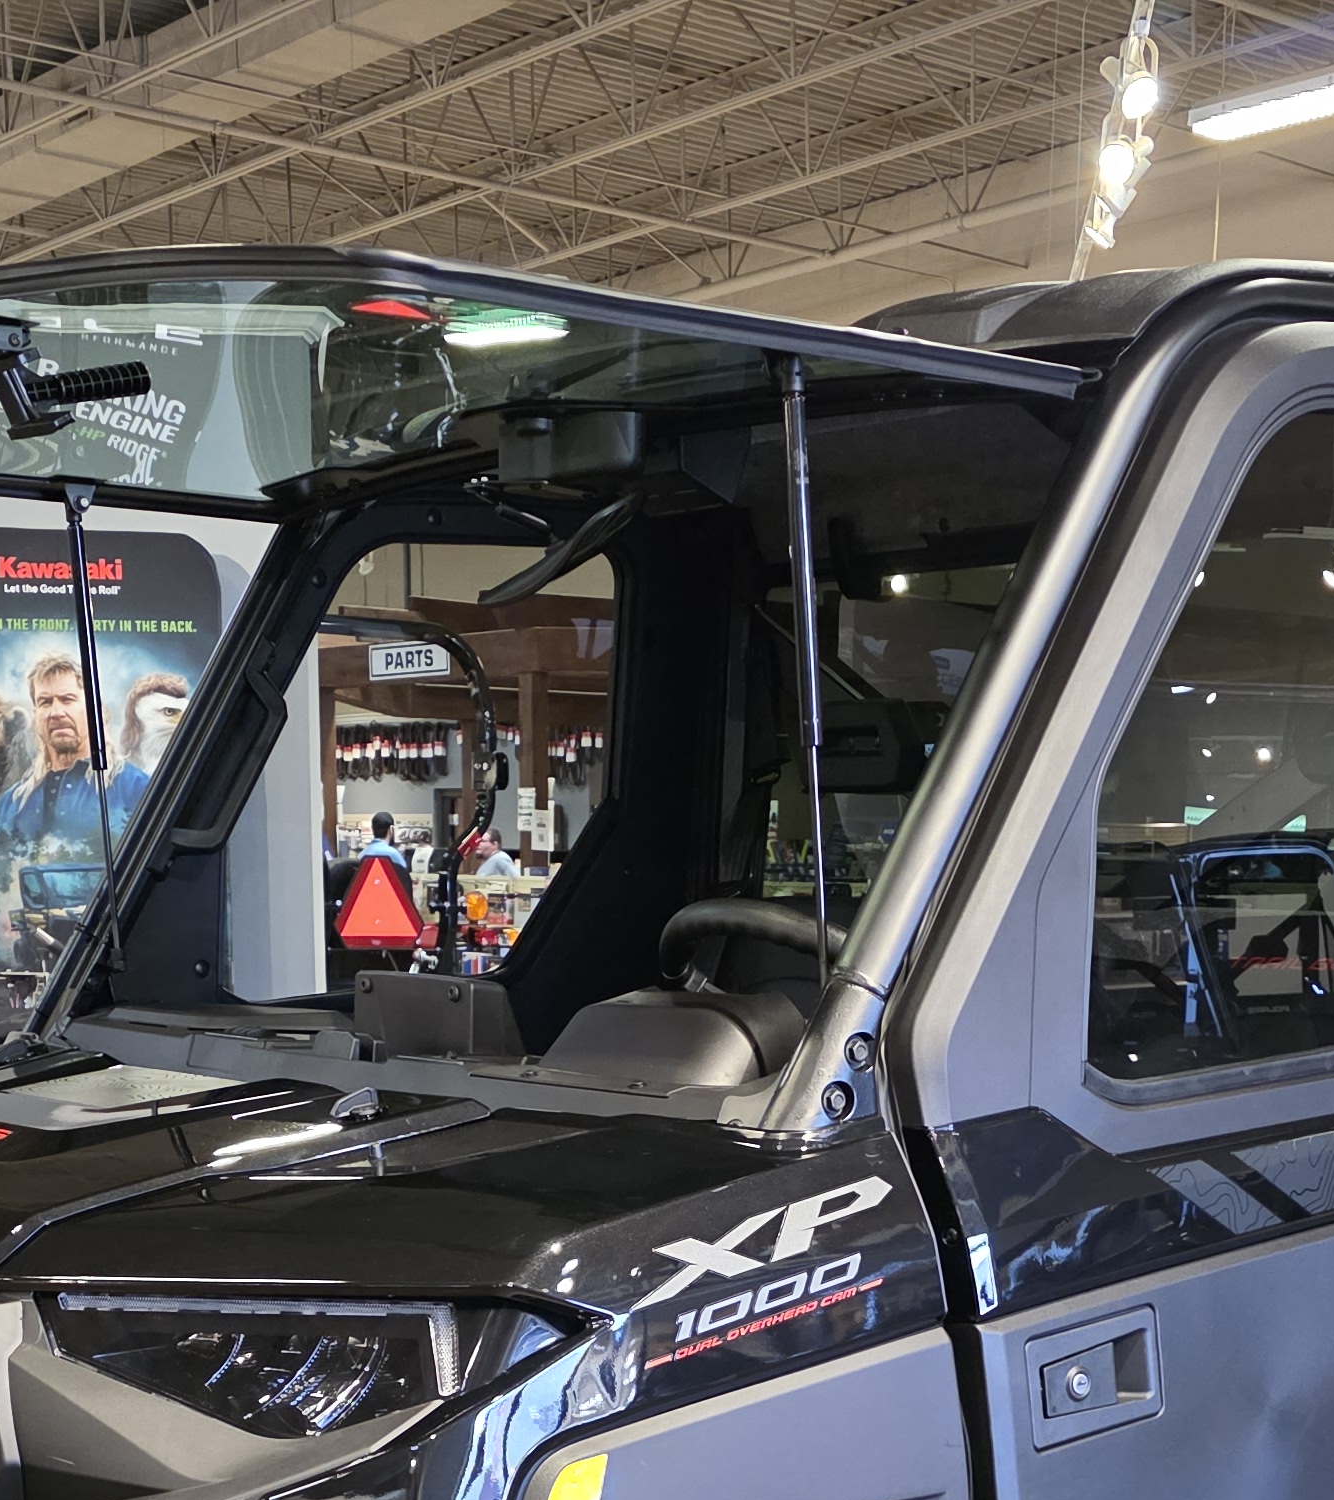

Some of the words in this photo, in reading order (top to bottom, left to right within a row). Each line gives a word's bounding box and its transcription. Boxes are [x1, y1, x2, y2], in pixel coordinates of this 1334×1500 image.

[75, 401, 179, 444] ENGINE
[107, 434, 161, 462] RIDGE
[4, 584, 20, 594] Let
[22, 584, 38, 594] the
[40, 584, 65, 595] Good
[7, 618, 29, 631] THE
[32, 619, 74, 631] FRONT.
[119, 620, 132, 632] IN
[135, 620, 158, 632] THE
[161, 620, 198, 633] BACK.
[385, 649, 434, 671] PARTS
[1231, 956, 1302, 970] TRAIL
[629, 1175, 893, 1311] XP
[675, 1252, 862, 1343] 1000
[674, 1337, 724, 1361] DUAL
[726, 1300, 818, 1341] OVERHEAD
[820, 1286, 858, 1308] CAM
